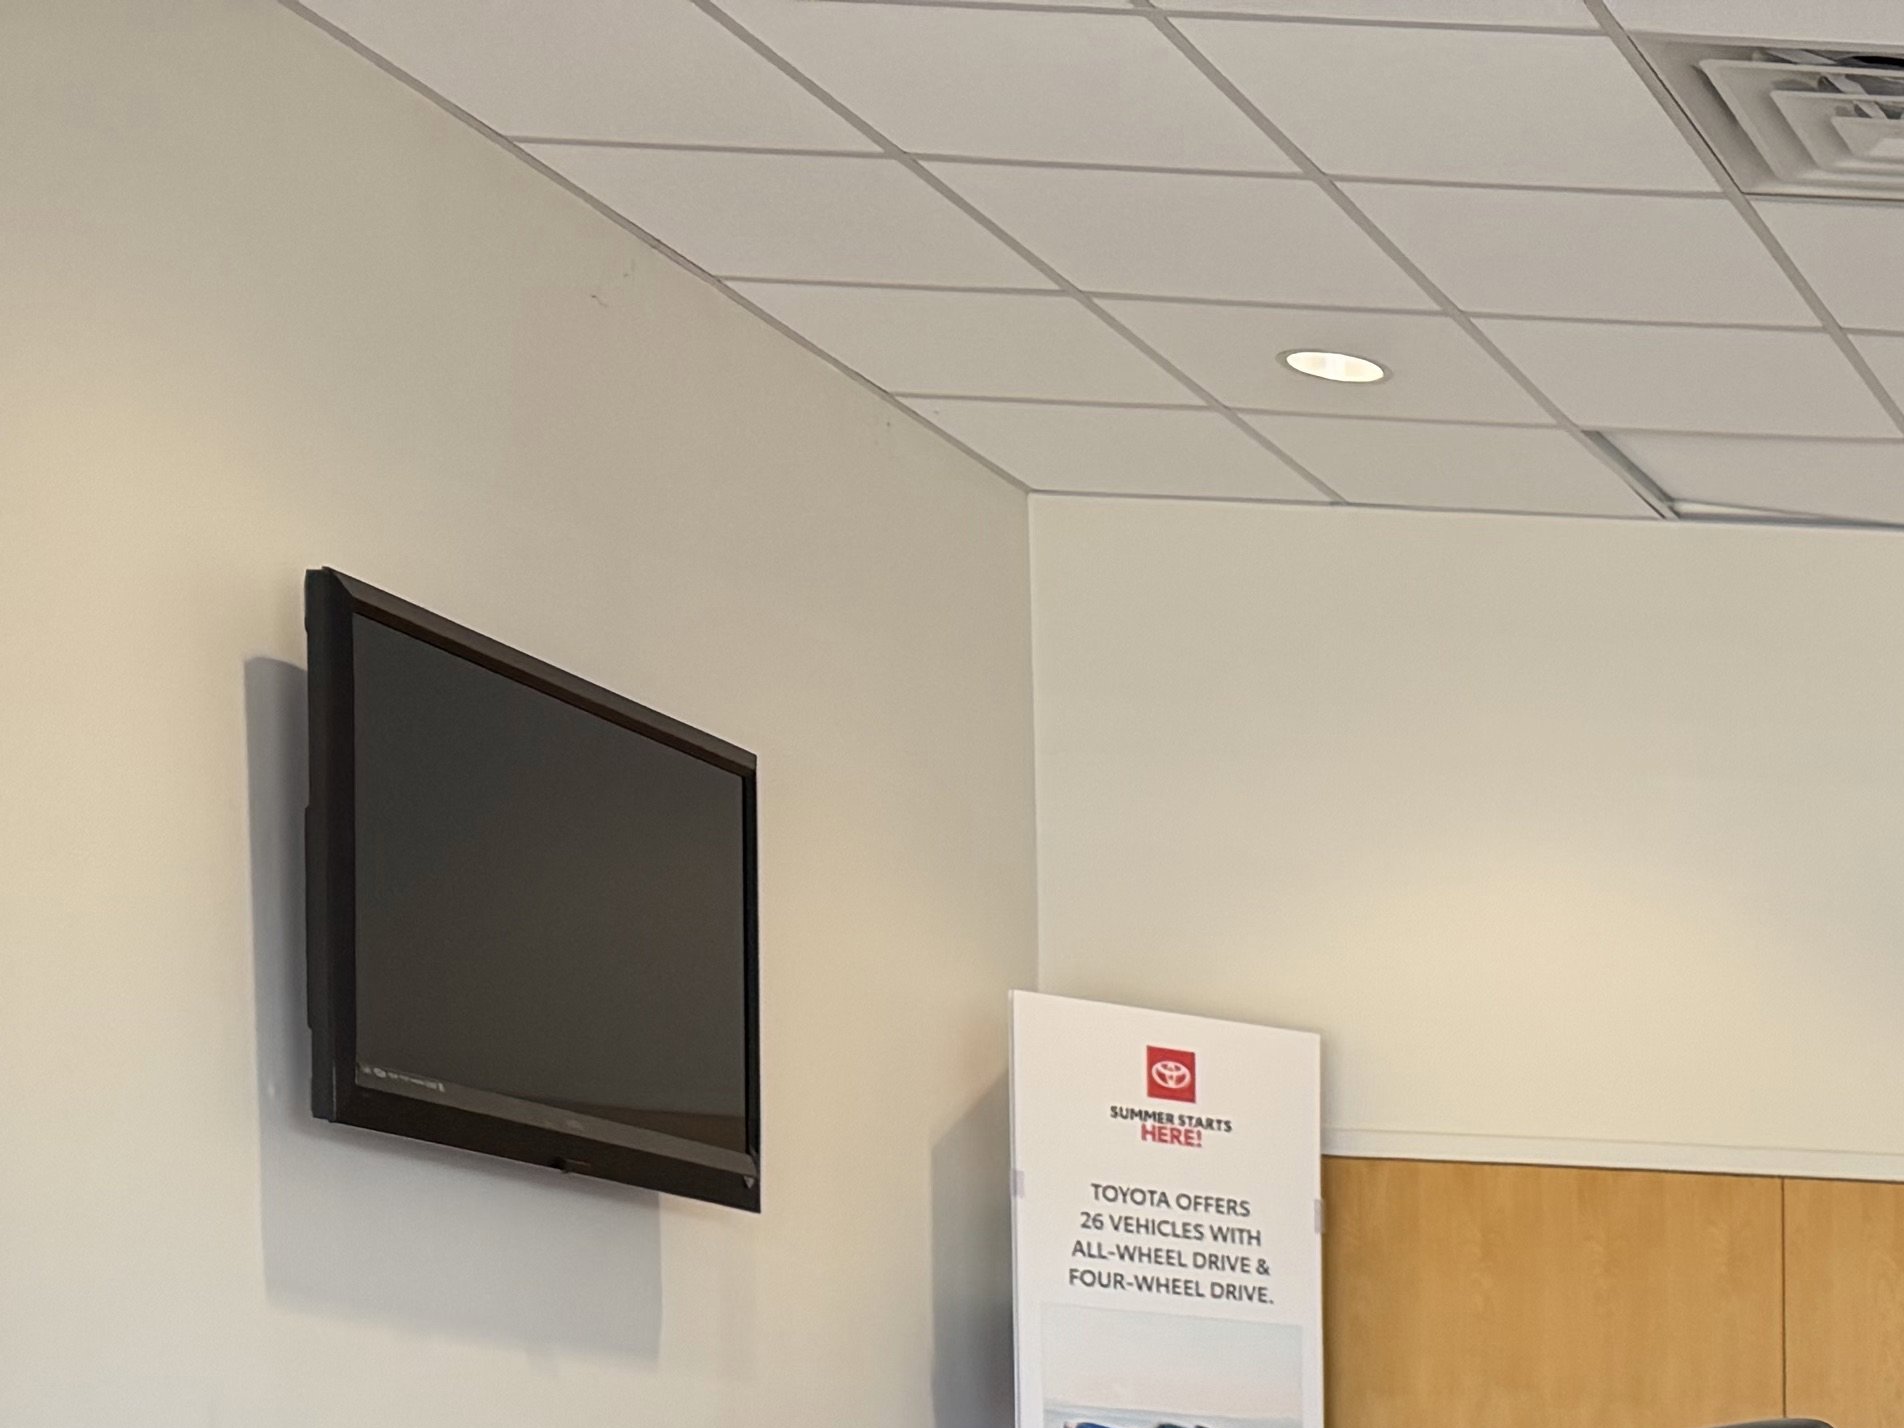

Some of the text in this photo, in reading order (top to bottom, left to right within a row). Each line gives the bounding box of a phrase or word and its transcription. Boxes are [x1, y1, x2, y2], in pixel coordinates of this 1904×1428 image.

[1110, 1106, 1233, 1133] SUMMER STARTS
[1141, 1124, 1203, 1148] HERE!
[1091, 1183, 1251, 1217] TOYOTA OFFERS
[1080, 1212, 1262, 1247] 26 VEHICLES WITH
[1072, 1240, 1270, 1276] ALL-WHEEL DRIVE &
[1069, 1268, 1275, 1304] FOUR-WHEEL DRIVE.
